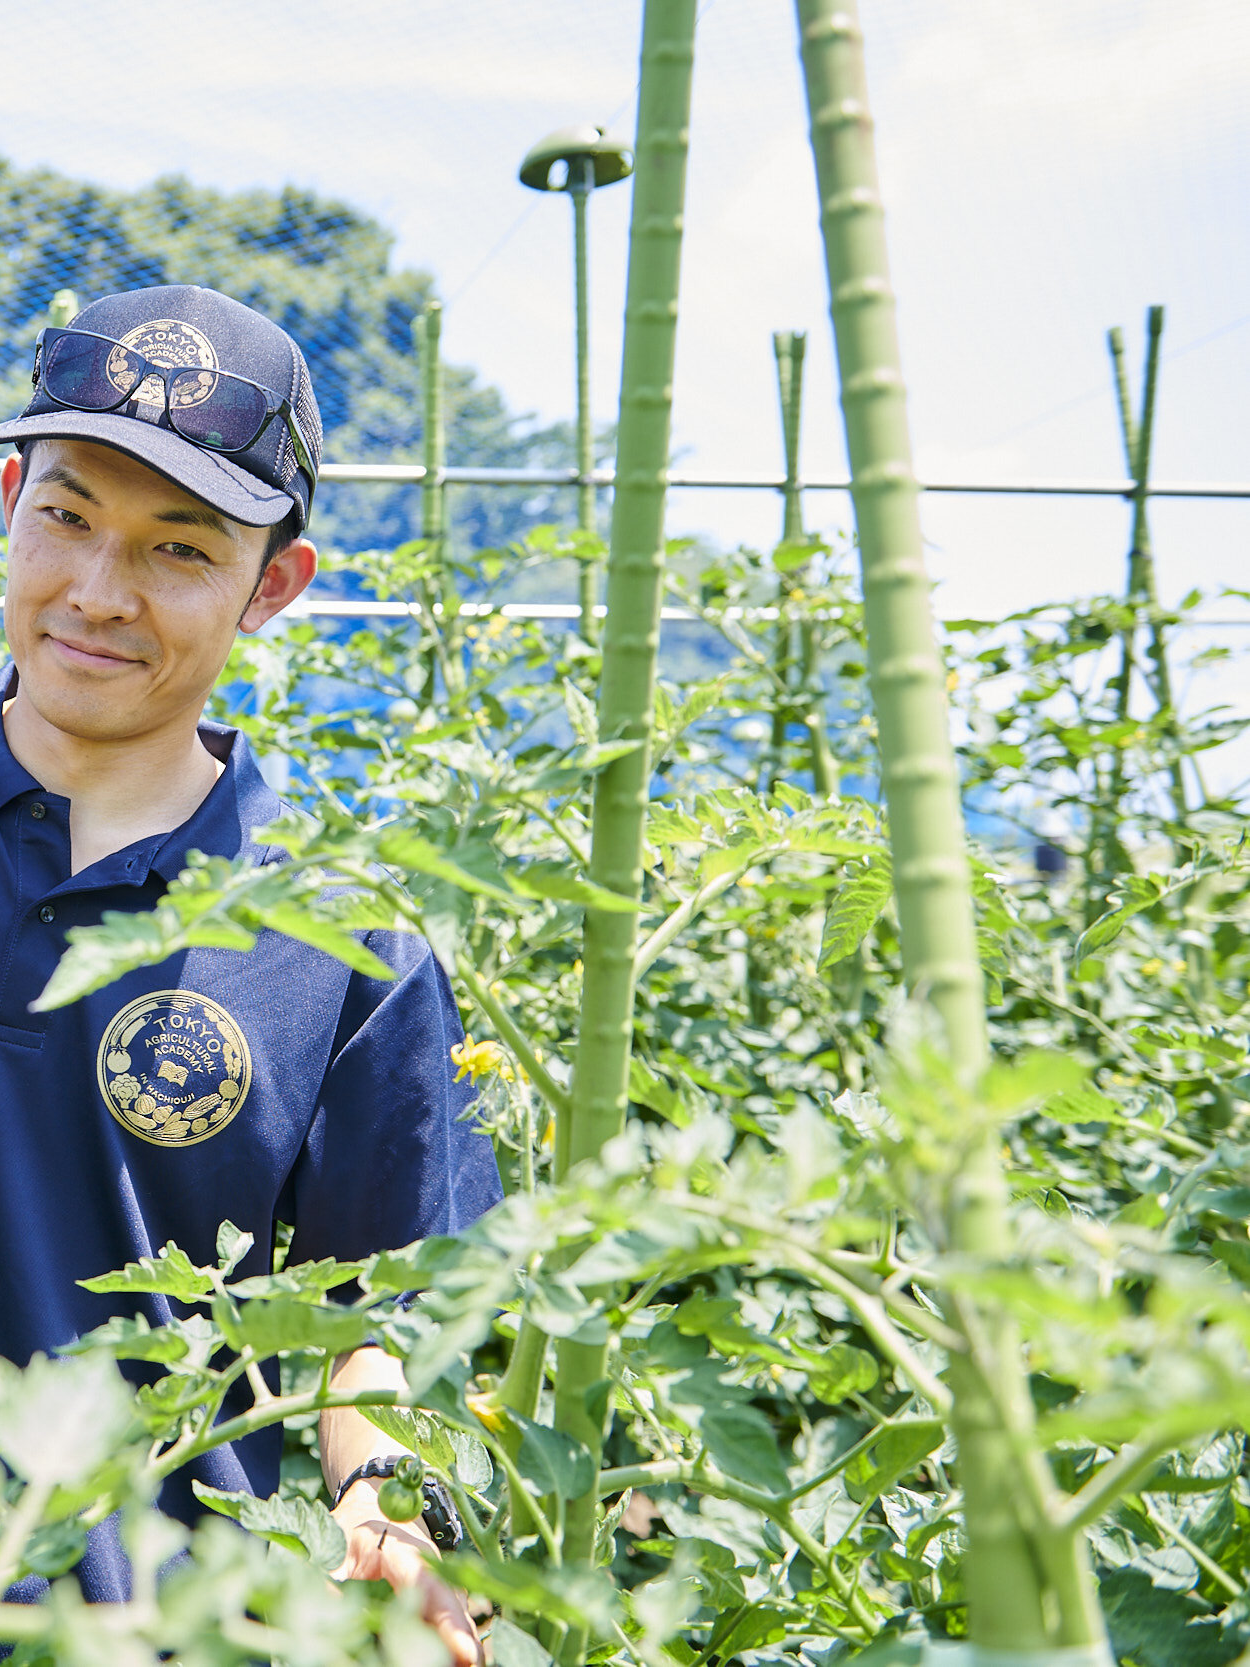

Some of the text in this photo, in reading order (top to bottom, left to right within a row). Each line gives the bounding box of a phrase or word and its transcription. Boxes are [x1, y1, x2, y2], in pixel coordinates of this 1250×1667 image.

[141, 331, 198, 355] TOKYO
[145, 350, 185, 367] ACADEMY
[153, 1014, 221, 1053] TOKYO
[144, 1033, 217, 1075] AGRICULTURAL
[153, 1044, 204, 1074] ACADEMY
[140, 1072, 196, 1105] IN HACHIOUJI
